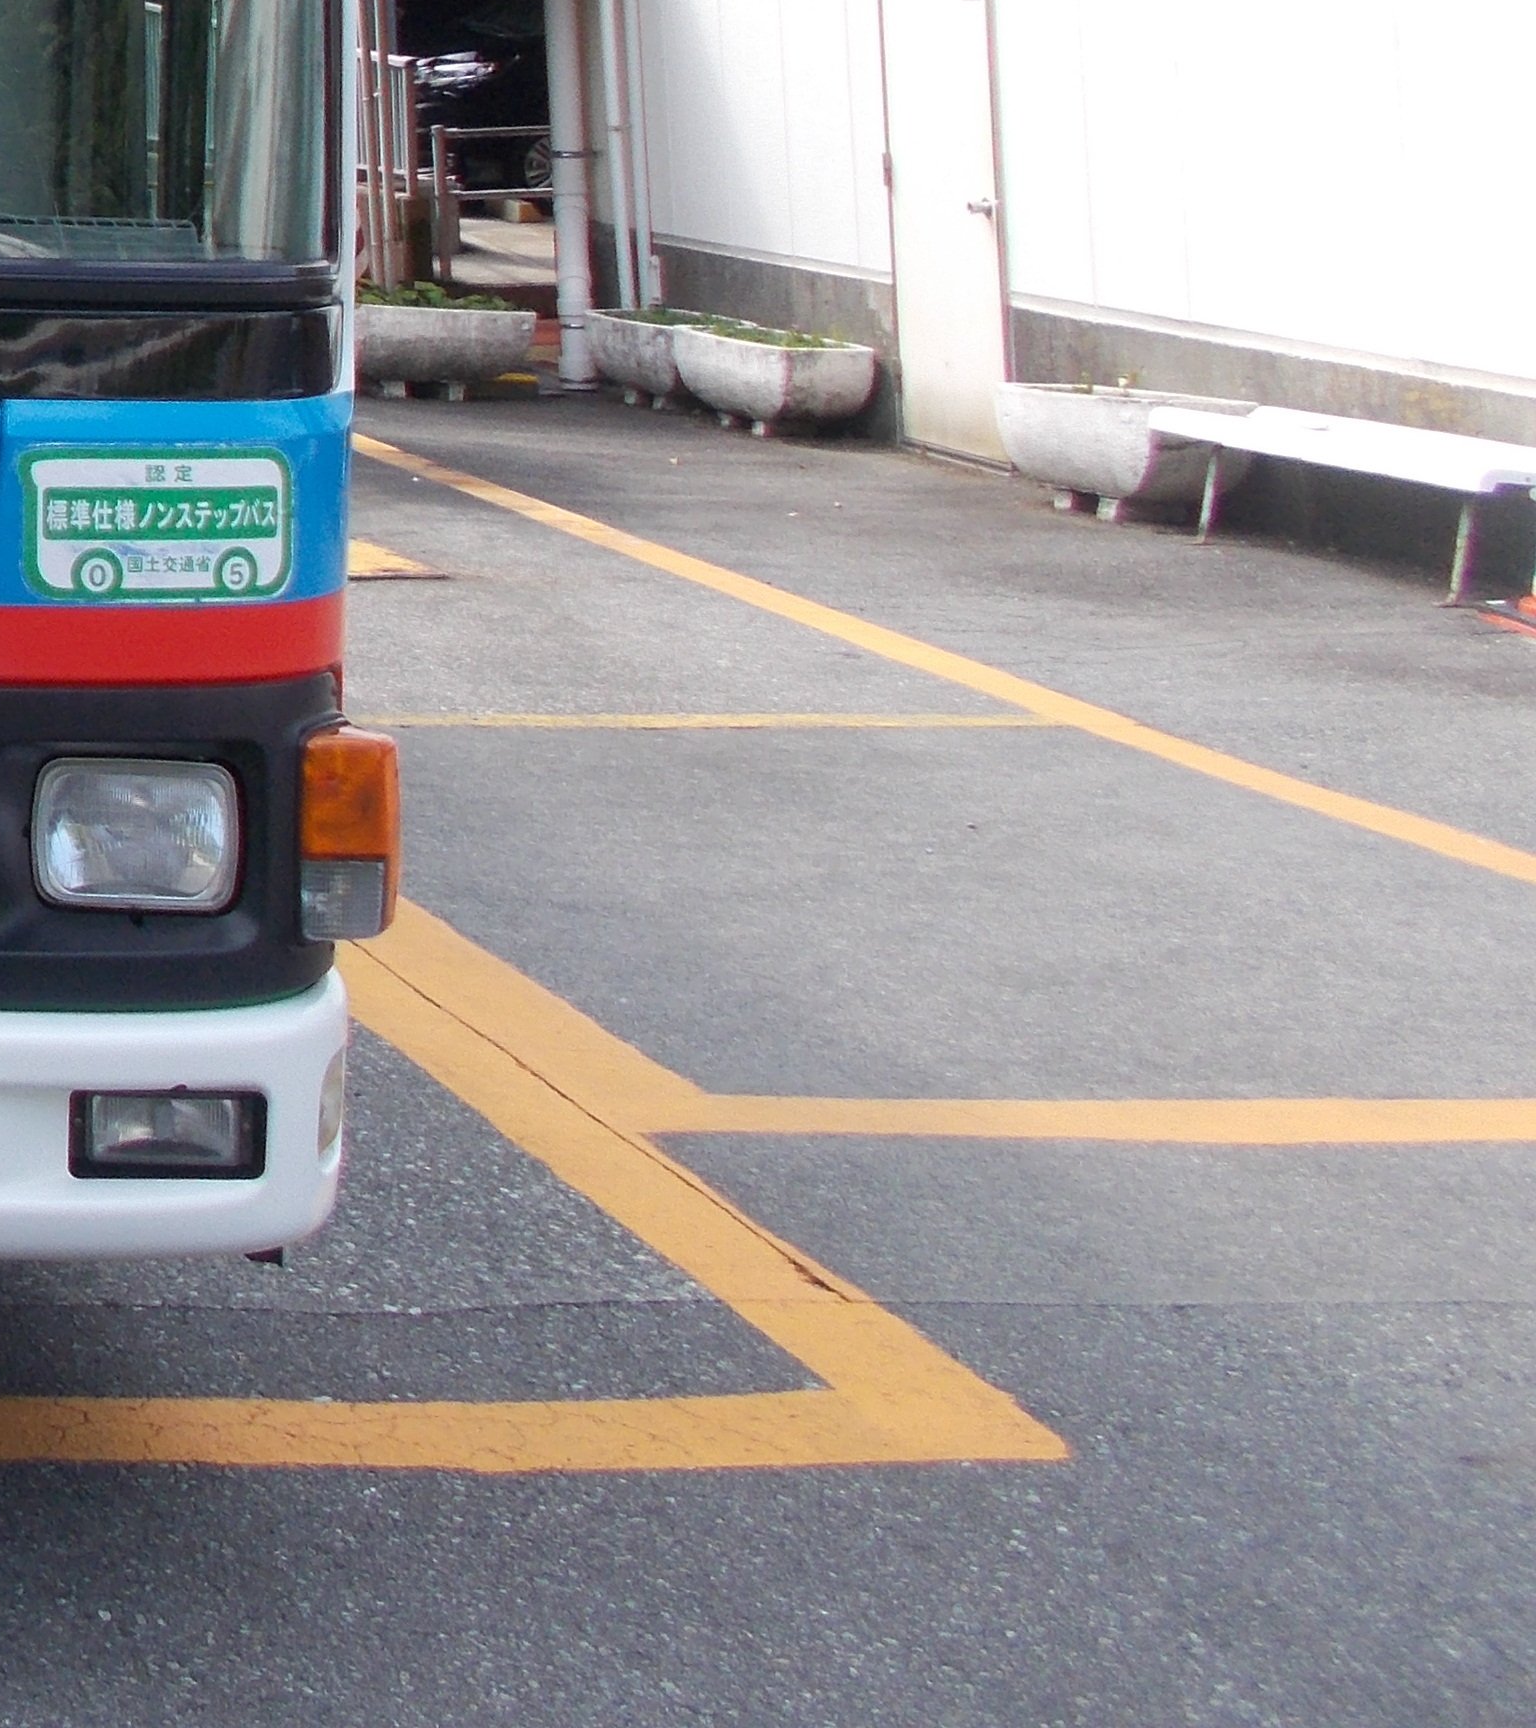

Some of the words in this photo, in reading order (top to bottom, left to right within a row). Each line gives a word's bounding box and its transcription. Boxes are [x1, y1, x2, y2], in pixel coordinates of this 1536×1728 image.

[145, 464, 193, 482] 認定
[46, 497, 276, 531] 標準仕様ノンステップバス
[128, 555, 211, 573] 国土交通省
[230, 563, 244, 585] 5
